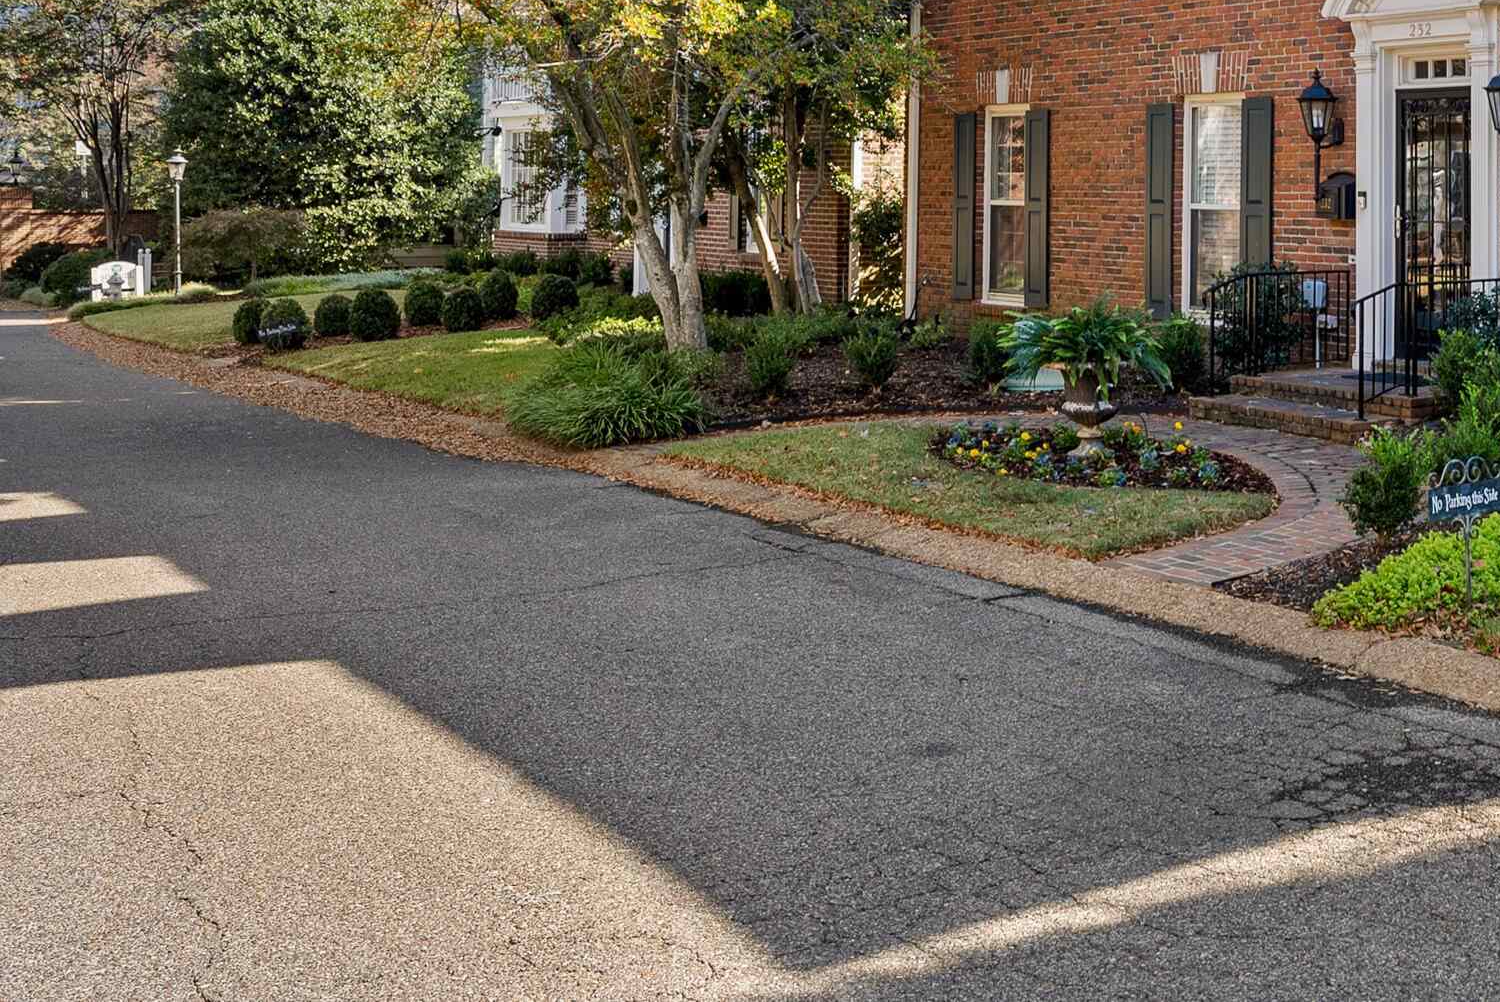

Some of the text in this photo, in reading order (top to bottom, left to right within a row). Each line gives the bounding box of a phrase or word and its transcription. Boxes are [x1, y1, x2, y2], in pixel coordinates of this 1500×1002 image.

[1432, 487, 1498, 514] No Parking this Side
